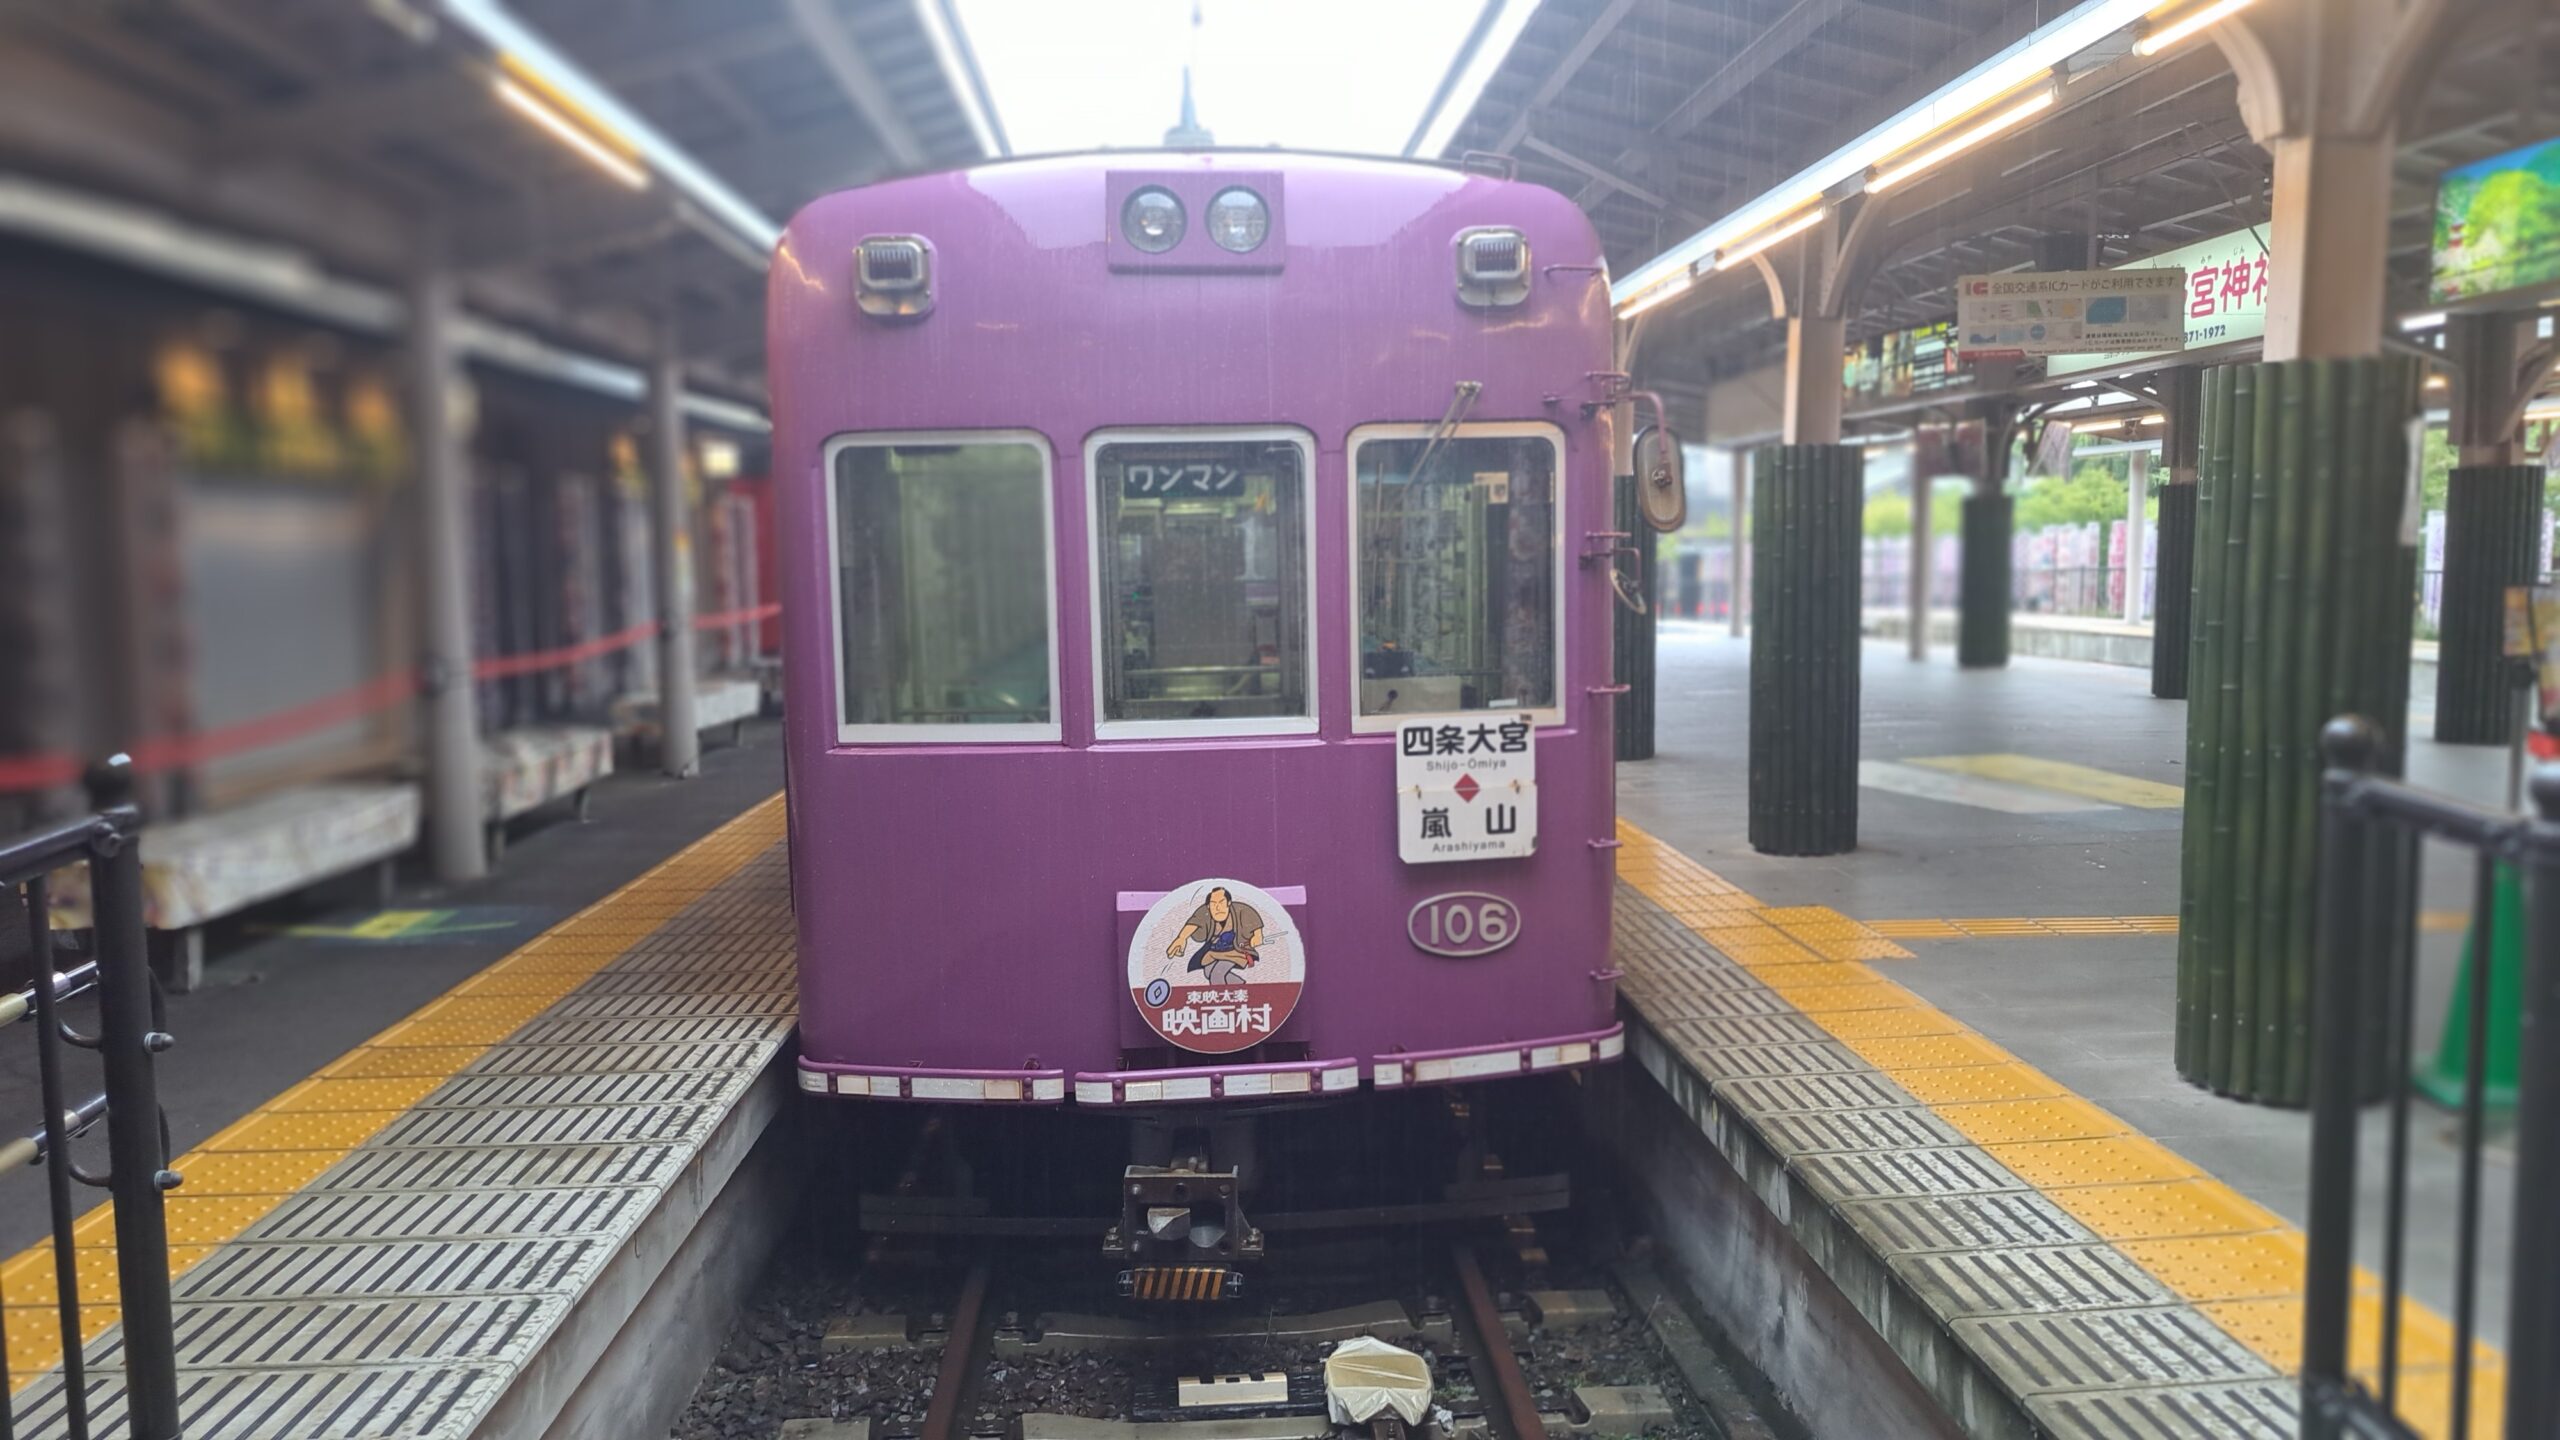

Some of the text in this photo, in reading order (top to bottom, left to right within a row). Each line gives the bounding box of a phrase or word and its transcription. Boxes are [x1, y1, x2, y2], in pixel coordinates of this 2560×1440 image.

[2184, 252, 2269, 318] 宮神
[1128, 464, 1238, 491] ワンマン
[1403, 719, 1529, 756] 四条大宮
[1432, 840, 1505, 853] Arashiyama
[1430, 903, 1507, 944] 106
[1185, 989, 1249, 1004] 東映太秦
[1162, 1003, 1272, 1036] 映画村
